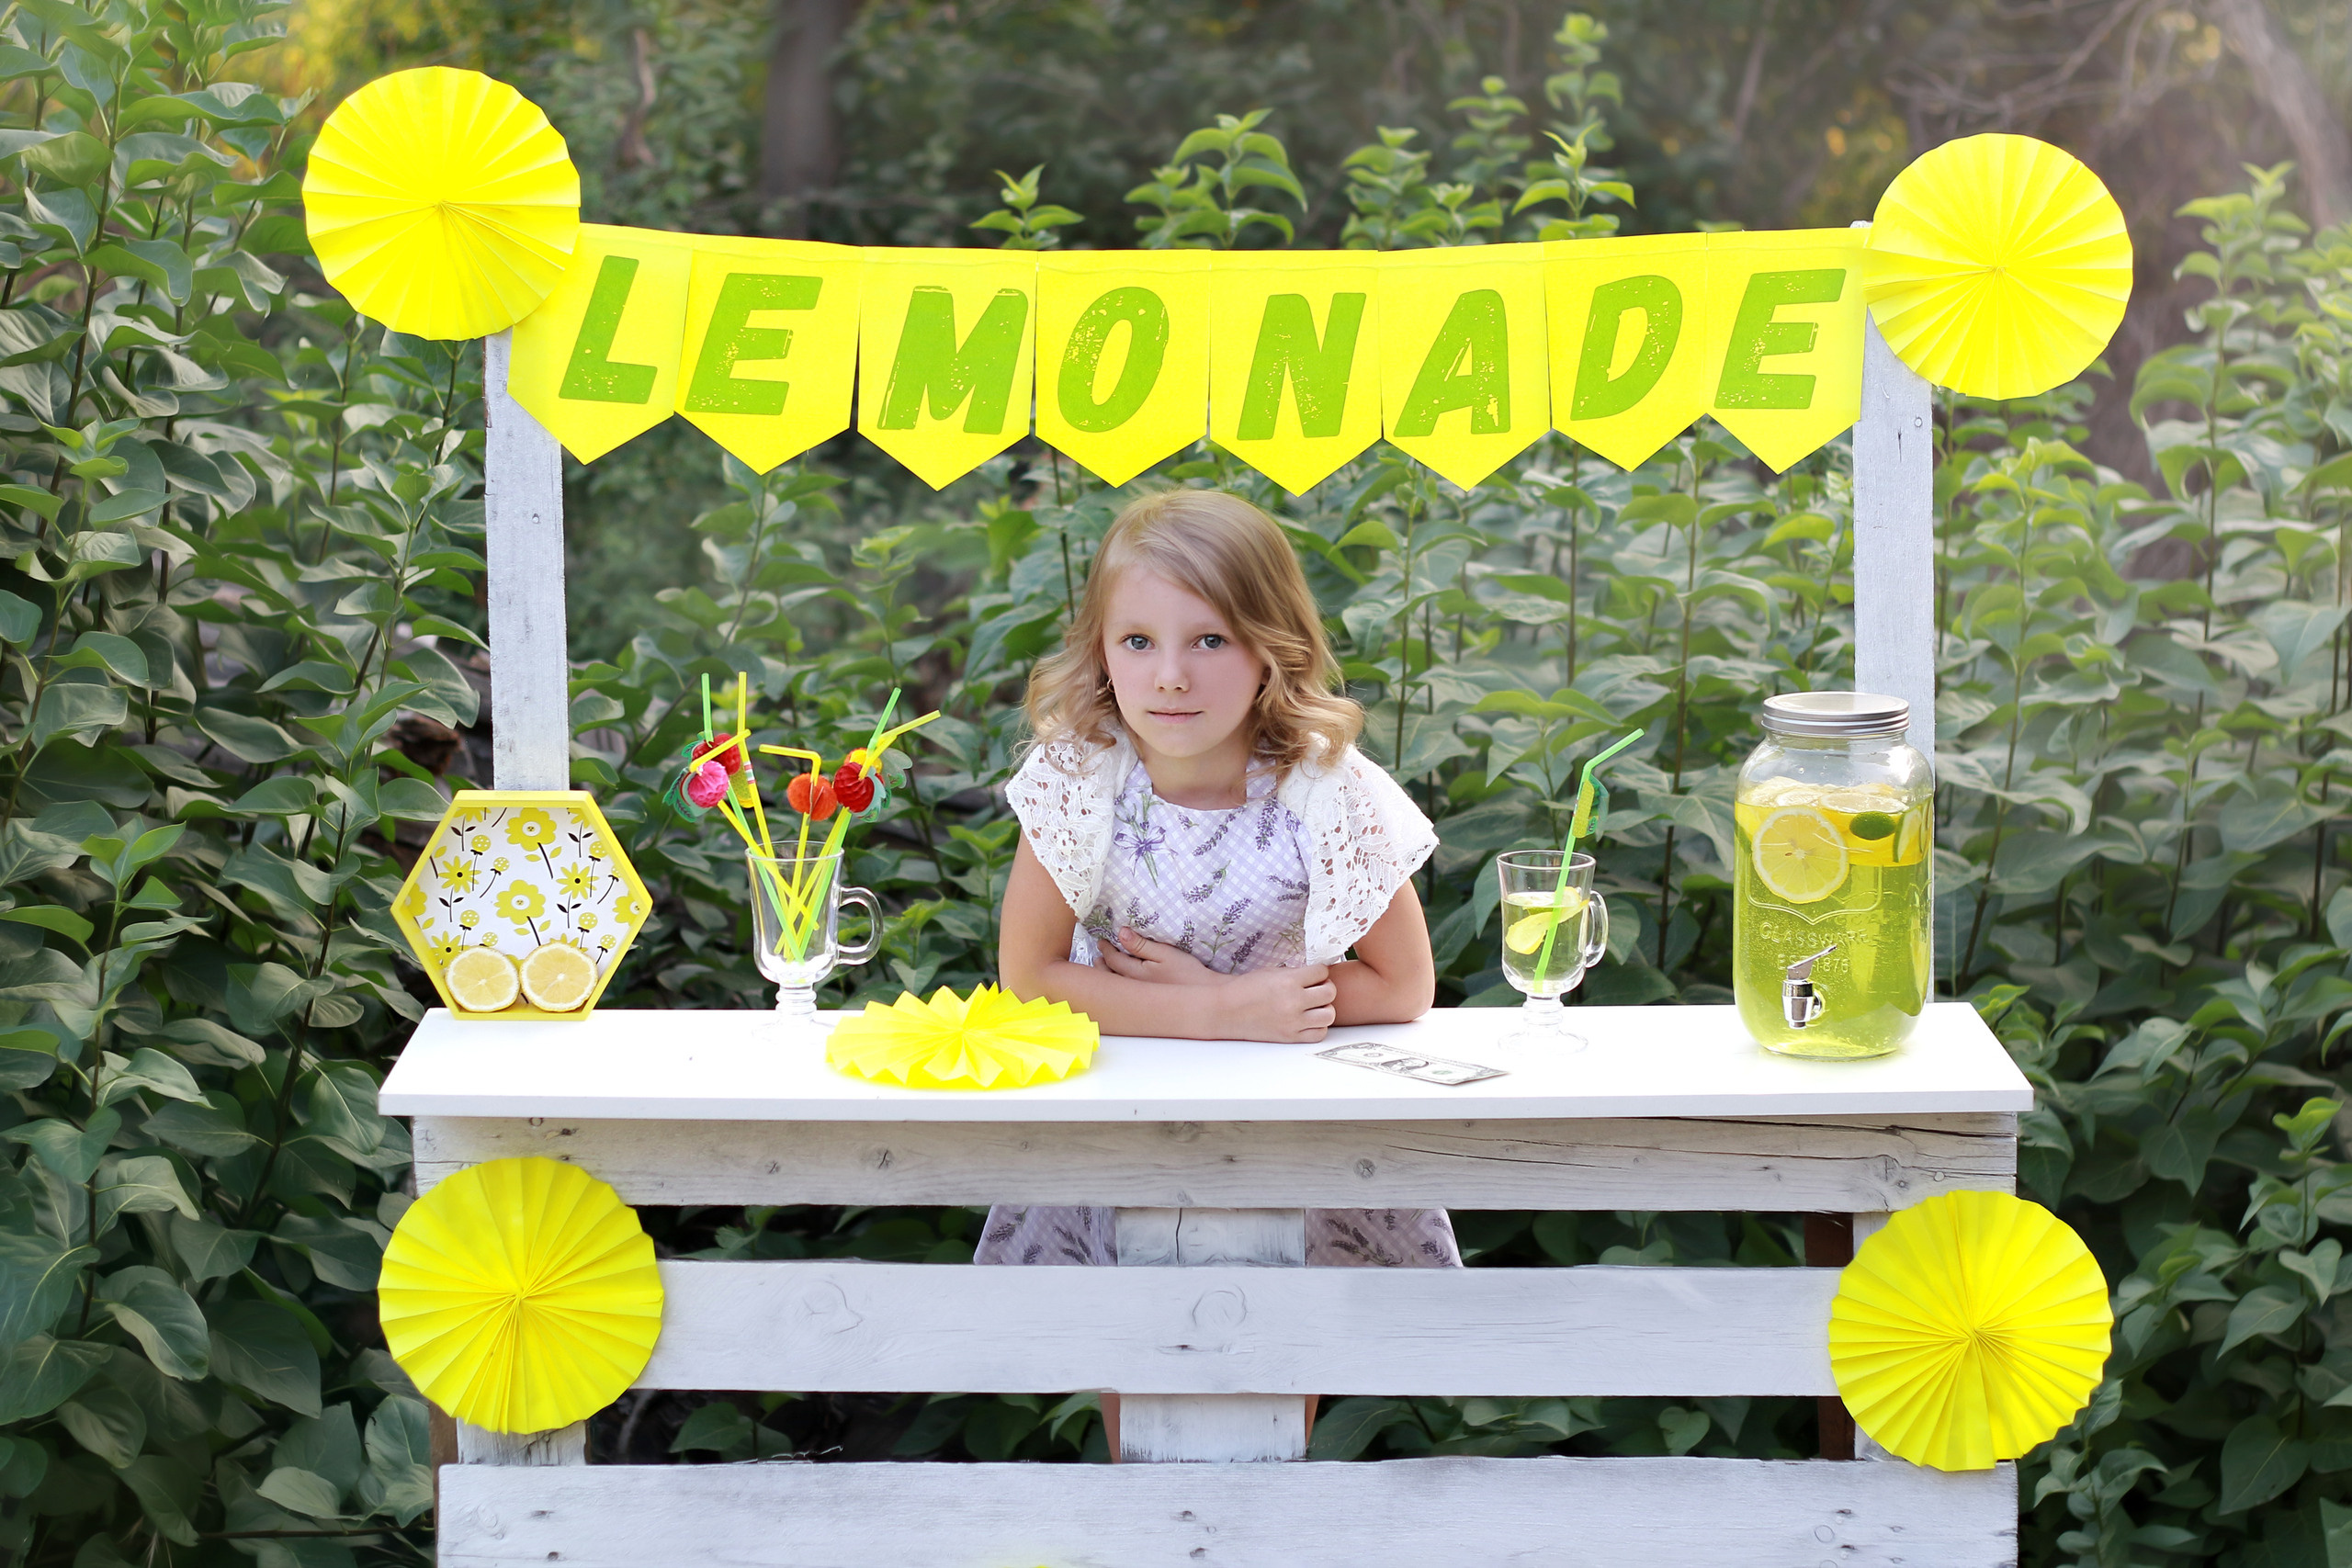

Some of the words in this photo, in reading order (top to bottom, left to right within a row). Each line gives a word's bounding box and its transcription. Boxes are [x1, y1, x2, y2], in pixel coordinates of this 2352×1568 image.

[558, 254, 1847, 441] LEMONADE
[1758, 921, 1871, 949] GLASSWARE
[1814, 956, 1850, 974] 1876
